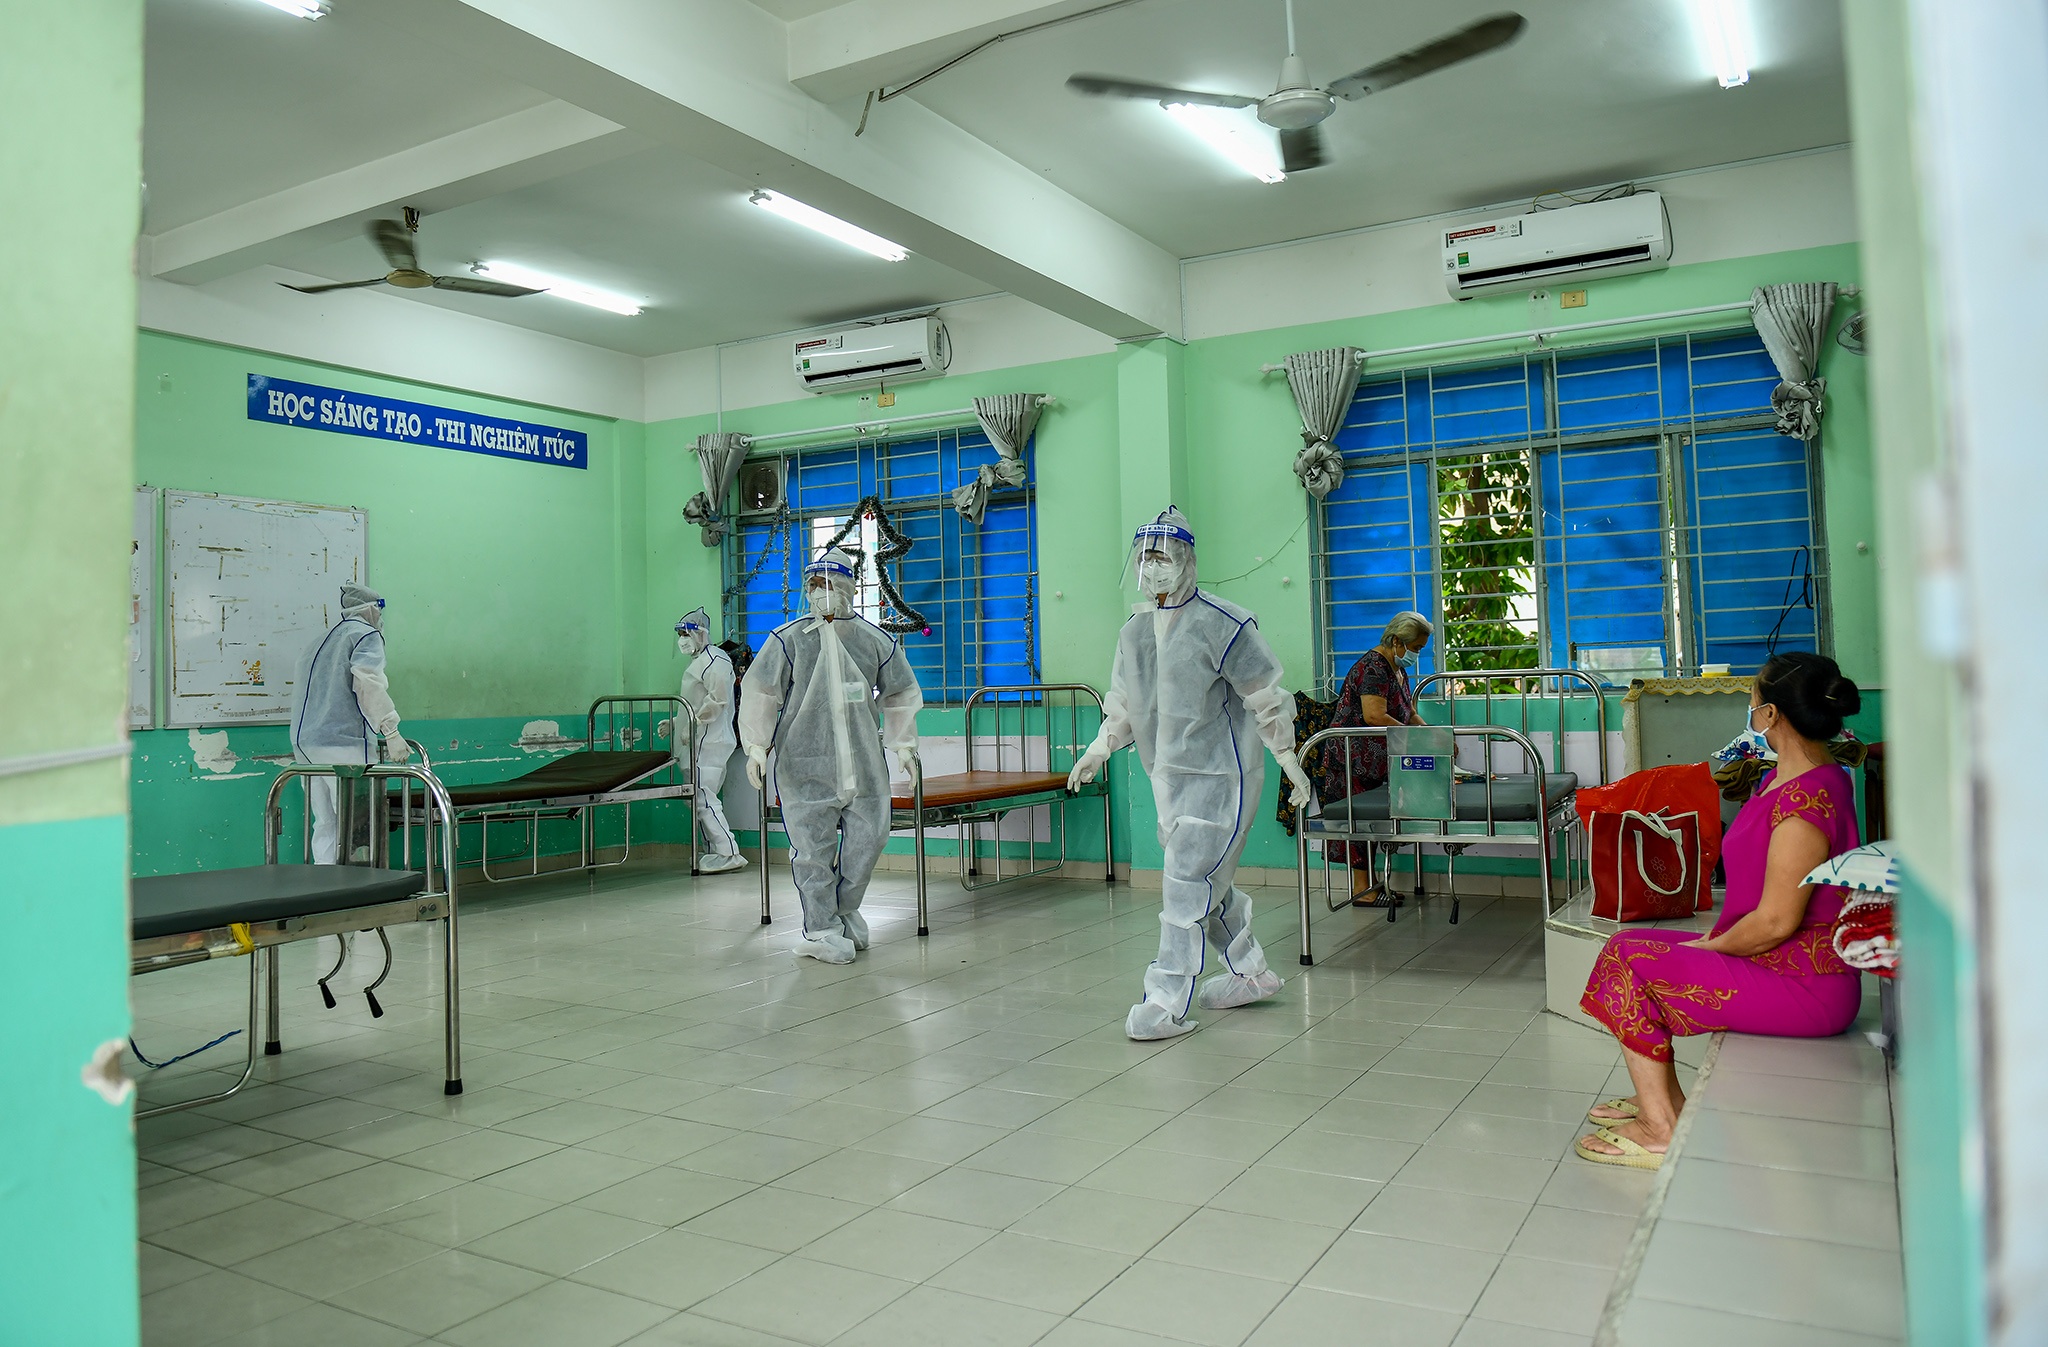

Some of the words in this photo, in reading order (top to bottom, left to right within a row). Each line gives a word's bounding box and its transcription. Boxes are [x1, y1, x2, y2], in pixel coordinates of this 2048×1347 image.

[267, 389, 315, 425] HỌC
[320, 394, 379, 431] SÁNG
[382, 409, 422, 441] TẠO
[435, 417, 467, 445] THI
[469, 425, 540, 456] NGHIÊM
[542, 431, 575, 461] TÚC
